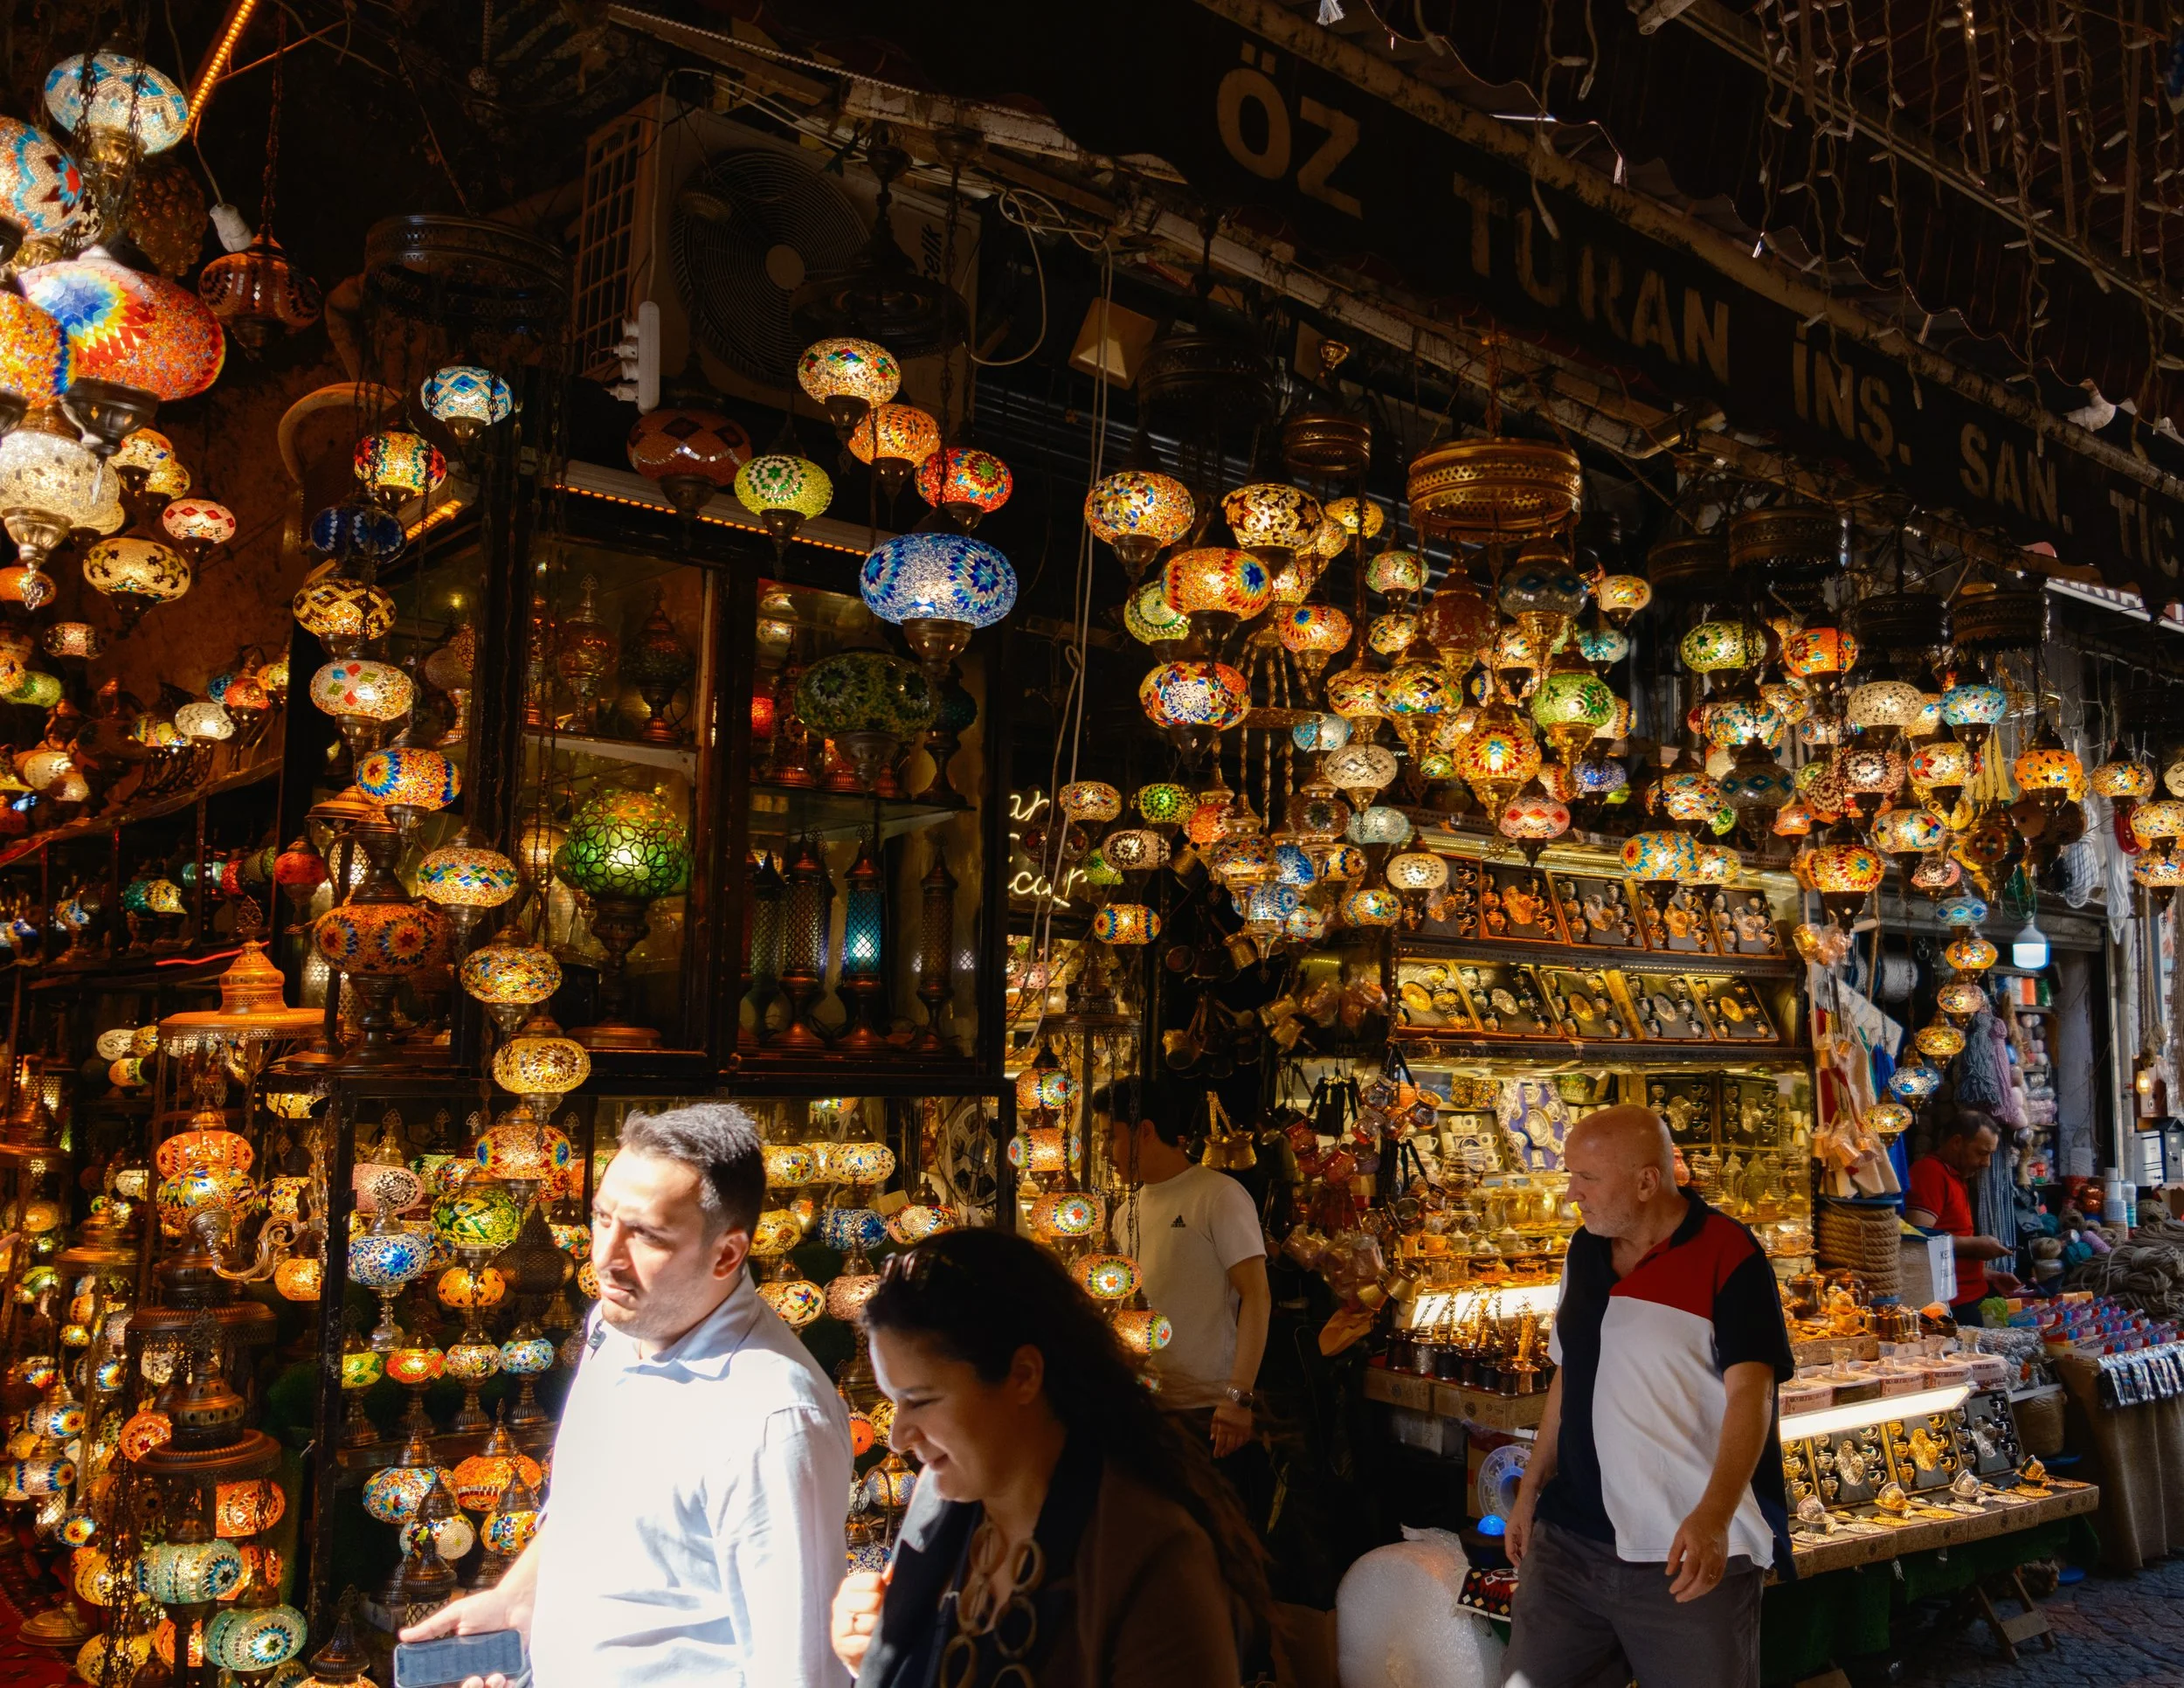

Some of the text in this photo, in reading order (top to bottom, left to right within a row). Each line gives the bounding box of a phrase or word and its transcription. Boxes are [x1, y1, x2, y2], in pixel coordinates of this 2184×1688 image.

[1216, 40, 1364, 221] ÖZ
[1452, 171, 1730, 387] TURAN
[1792, 319, 1912, 474] İNŞ.
[1959, 421, 2074, 535] SAN.
